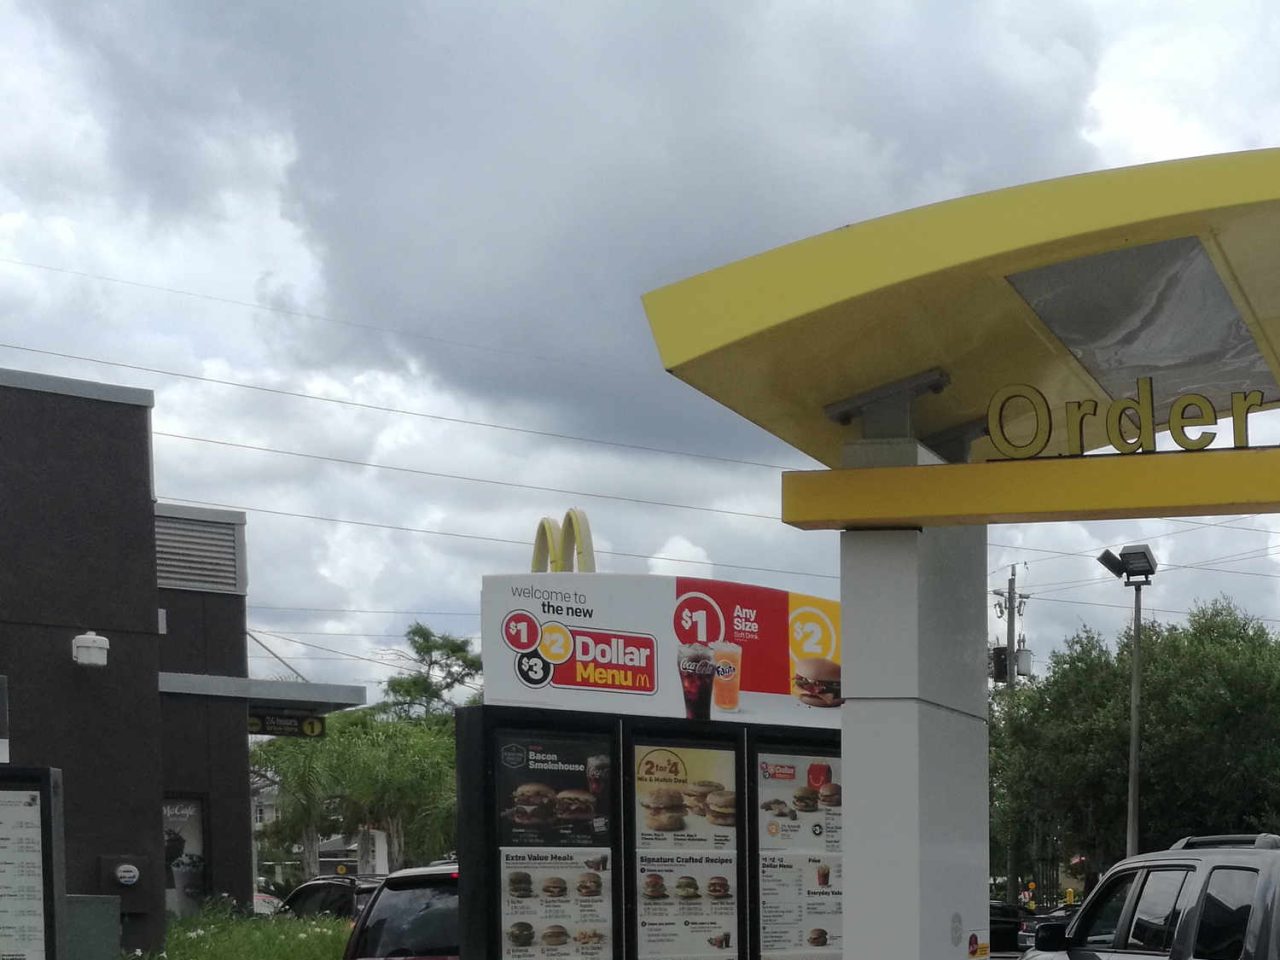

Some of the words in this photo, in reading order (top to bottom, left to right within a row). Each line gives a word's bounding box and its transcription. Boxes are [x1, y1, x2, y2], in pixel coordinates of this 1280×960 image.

[987, 375, 1265, 459] Order
[511, 585, 572, 602] welcome
[573, 591, 587, 604] to
[541, 601, 564, 616] the
[566, 604, 594, 618] new
[733, 604, 756, 621] Any
[509, 621, 528, 643] $1
[681, 608, 707, 642] $1
[733, 617, 759, 632] Size
[794, 621, 822, 653] $2
[575, 635, 650, 667] Dollar
[521, 657, 544, 680] $3
[575, 661, 633, 687] Menu
[528, 751, 558, 761] Bacon
[528, 760, 585, 771] Smokehouse
[644, 760, 655, 775] 2
[655, 763, 667, 772] for
[505, 853, 526, 861] Extra
[527, 853, 549, 861] Value
[550, 853, 574, 861] Meals
[640, 856, 675, 864] Signature
[676, 855, 703, 864] Crafted
[705, 856, 733, 865] Recipes
